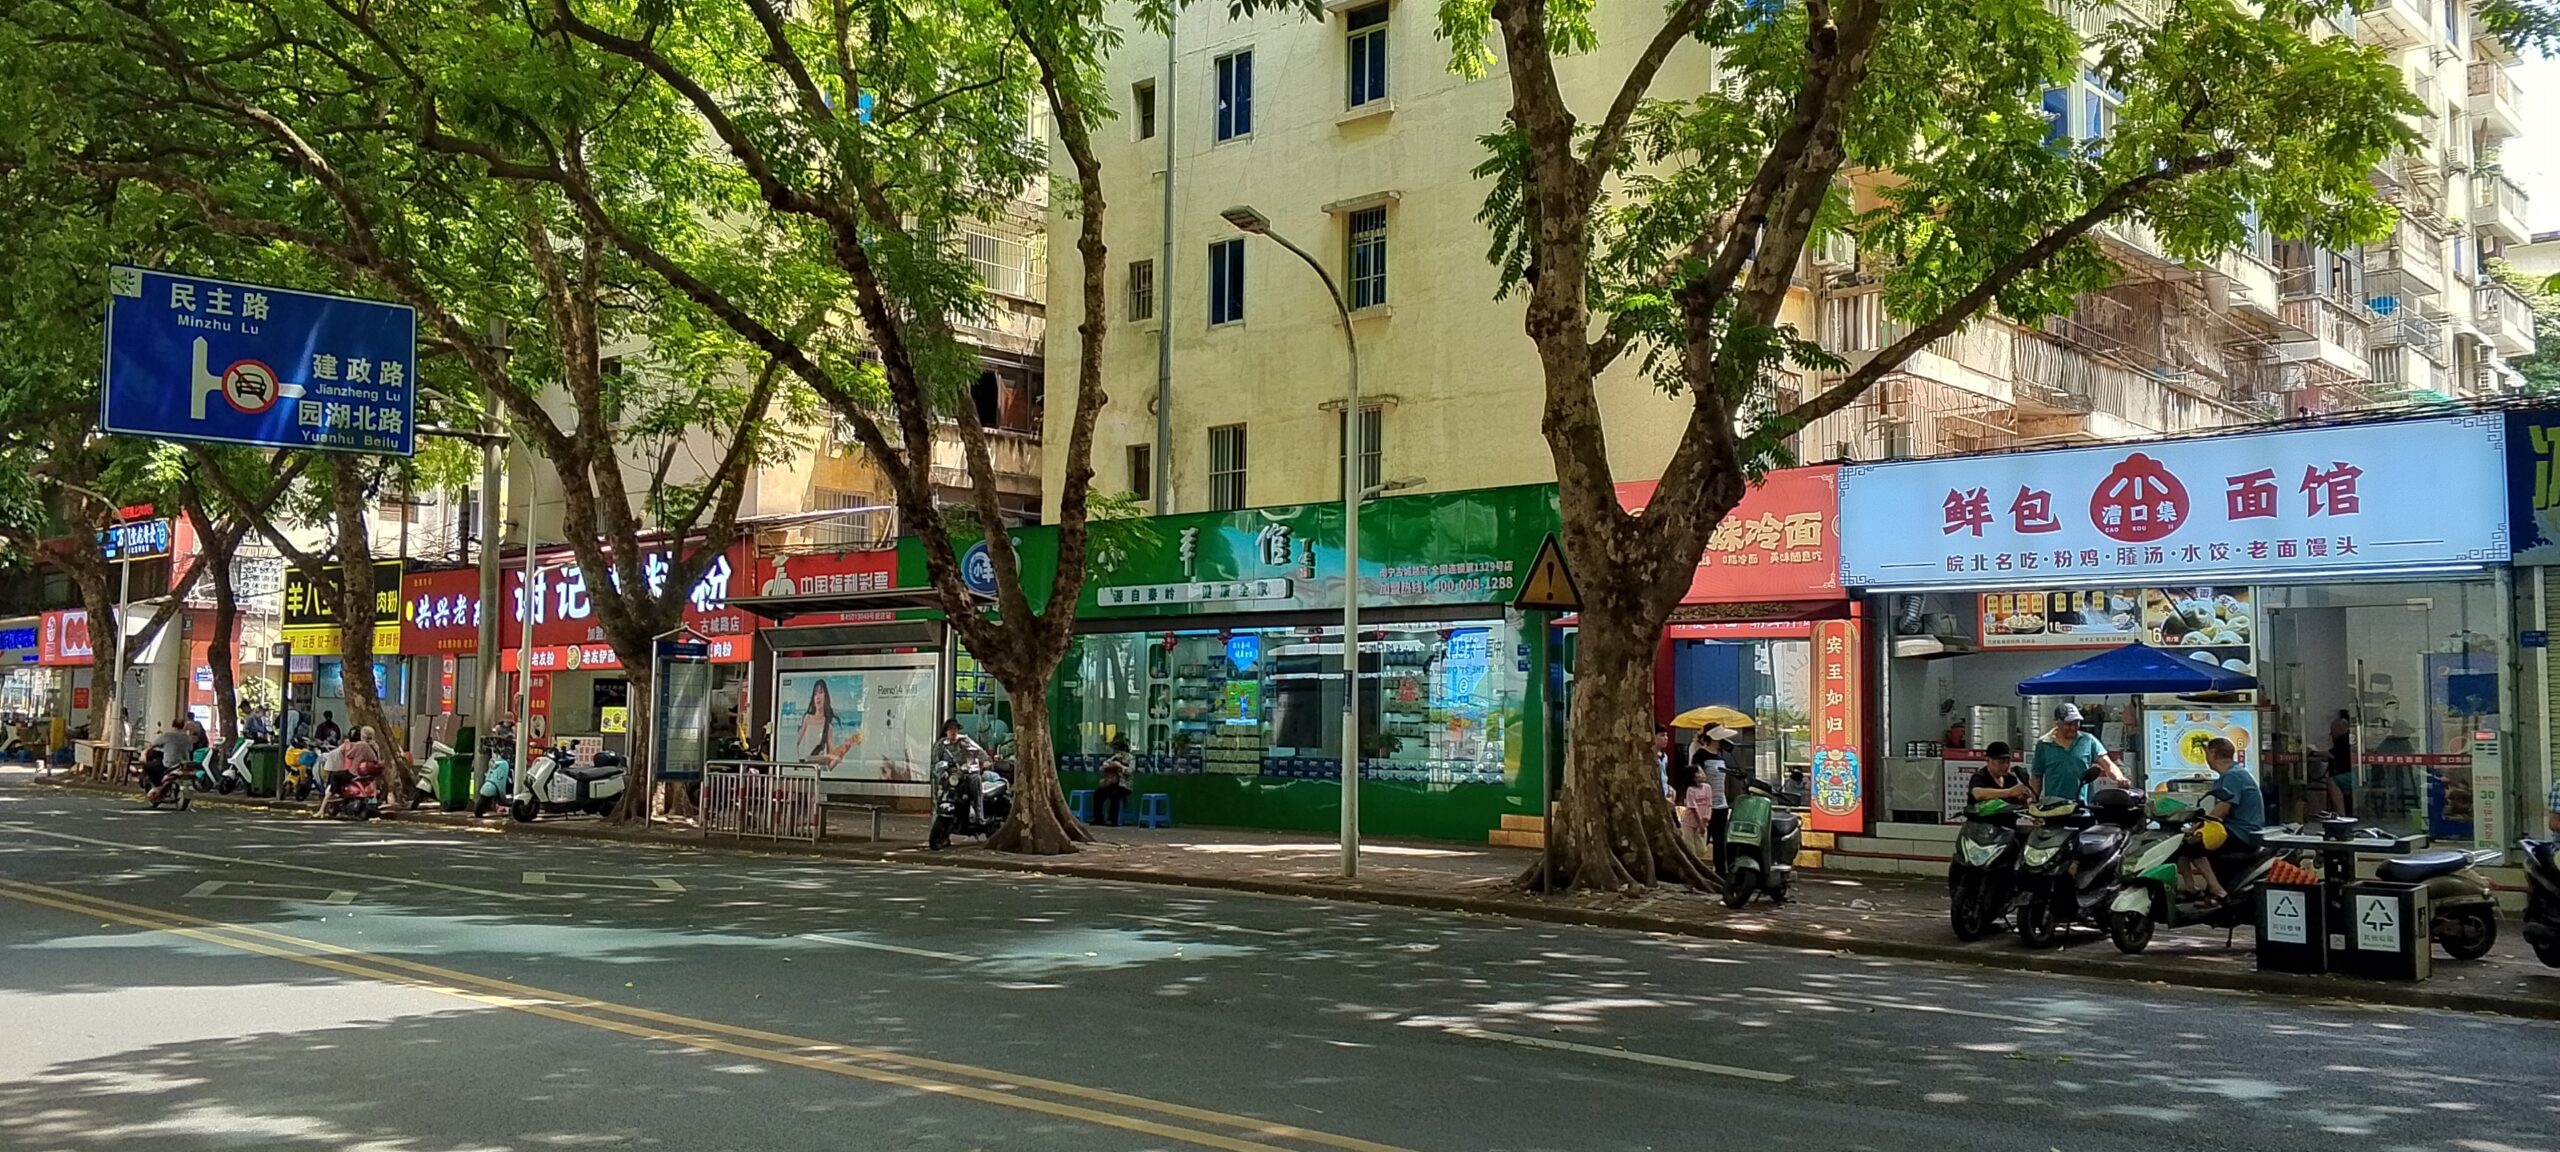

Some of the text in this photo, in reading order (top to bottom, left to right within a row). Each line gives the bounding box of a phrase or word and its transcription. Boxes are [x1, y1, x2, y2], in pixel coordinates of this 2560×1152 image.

[170, 283, 270, 321] 民主路
[177, 314, 259, 335] Minzhu Lu
[312, 353, 404, 388] 建政路
[315, 383, 402, 403] Jianzheng Lu
[298, 400, 404, 435] 园湖北路
[302, 430, 400, 449] Yuanhu Beilu
[2225, 460, 2364, 523] 面馆
[1941, 483, 2064, 539] 鲜包
[800, 571, 889, 595] 中国福利彩票
[1111, 587, 1176, 604] 源自秦岭
[700, 615, 740, 633] 古城路店
[2152, 627, 2162, 643] 6
[1825, 635, 1844, 735] 宾至如归
